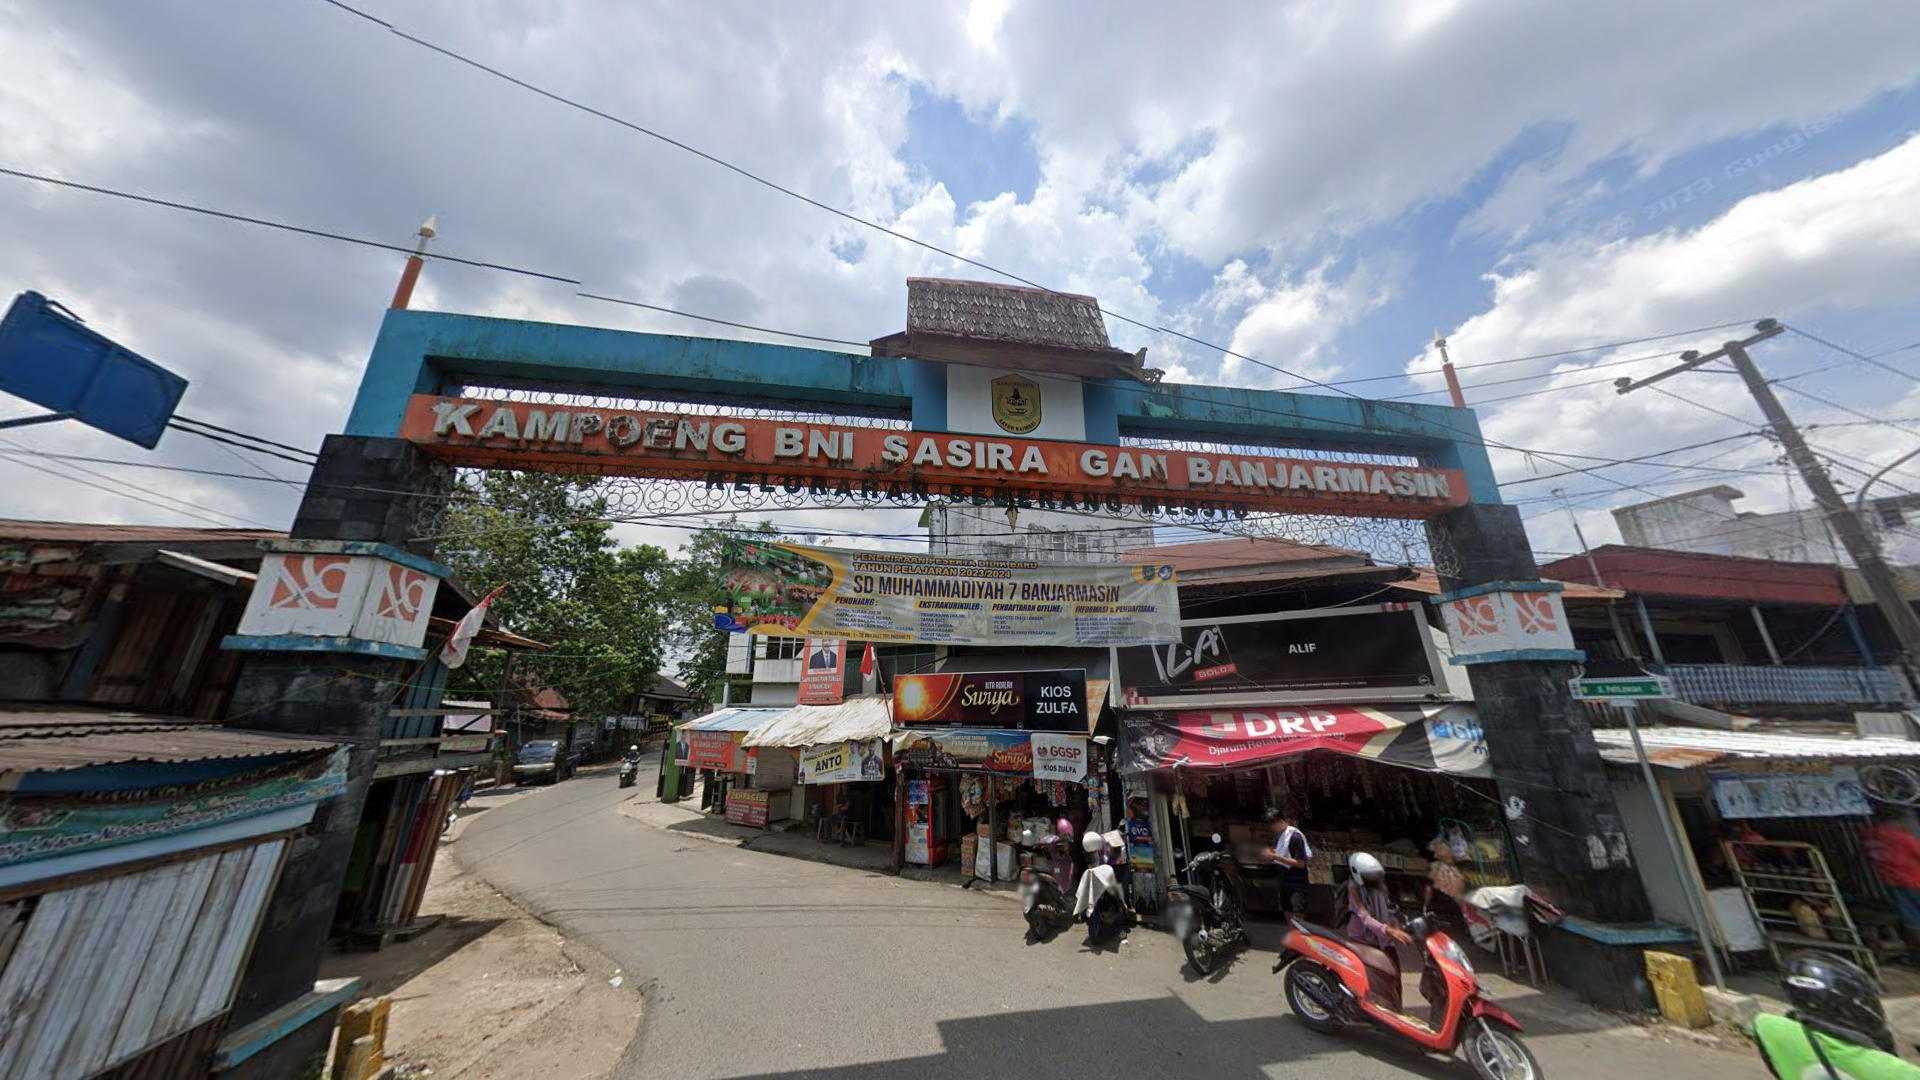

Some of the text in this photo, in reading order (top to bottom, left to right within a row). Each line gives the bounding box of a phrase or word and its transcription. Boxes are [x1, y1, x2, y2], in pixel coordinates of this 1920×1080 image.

[431, 402, 746, 454] KAMPOENG
[774, 427, 853, 461] BNI
[1187, 457, 1450, 498] BANJARMASIN
[706, 471, 929, 501] KELURAHAN
[853, 552, 1038, 570] PENERIMAAN PESERTA DIDIK BARU
[853, 562, 1012, 579] TAHUN PELAJARAN 2023/2024
[853, 575, 1120, 602] SD MUHAMMADIYAH 7 BANJARMASIN
[991, 603, 1037, 612] PENDAFTARAN
[1075, 605, 1109, 613] INFORMASI
[1288, 643, 1317, 654] ALIF
[1198, 666, 1227, 678] BOLD
[985, 681, 995, 690] KITA
[1040, 685, 1072, 698] KIOS
[961, 683, 1020, 715] Surya
[1036, 701, 1078, 715] ZULFA
[1242, 709, 1338, 737] DRP
[1050, 745, 1081, 759] GGSP
[1208, 742, 1247, 755] Djarum
[814, 754, 843, 773] ANTO
[993, 750, 1032, 769] Surya
[1043, 764, 1077, 774] KIOS ZULFA
[1131, 826, 1149, 836] evo
